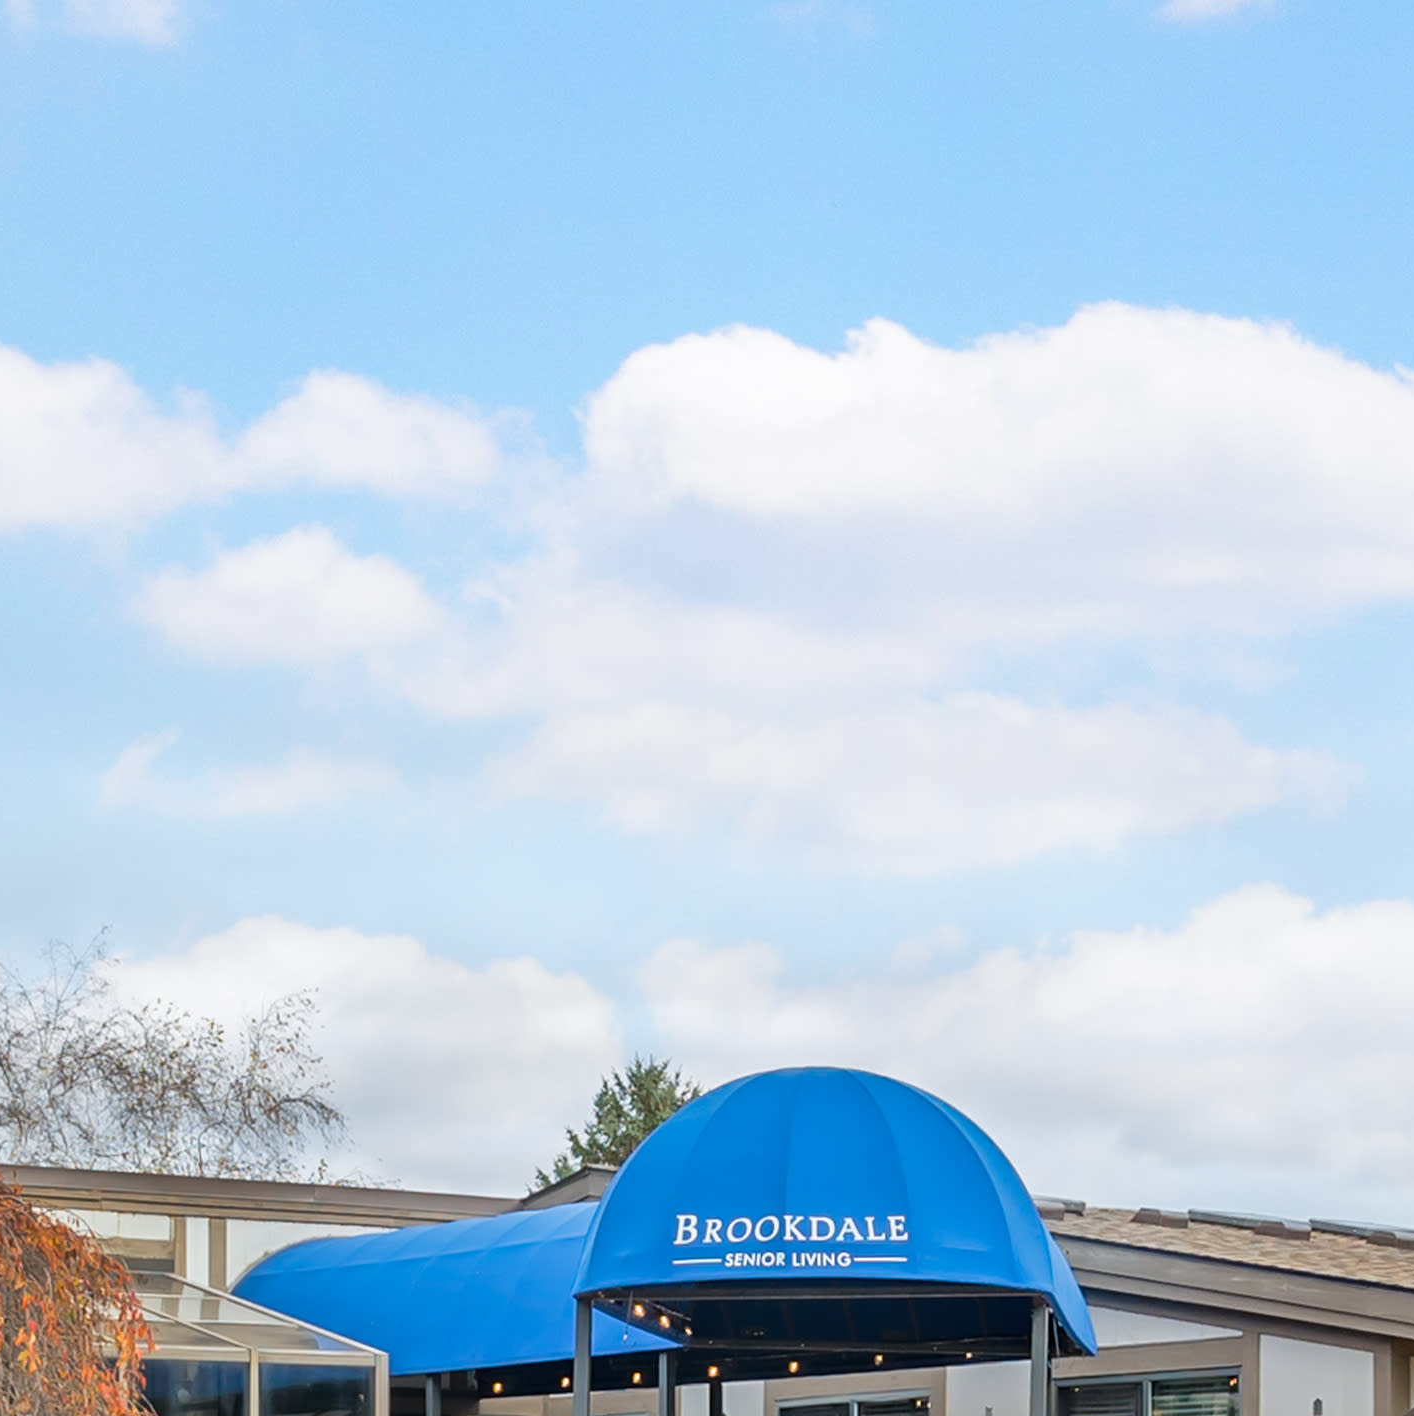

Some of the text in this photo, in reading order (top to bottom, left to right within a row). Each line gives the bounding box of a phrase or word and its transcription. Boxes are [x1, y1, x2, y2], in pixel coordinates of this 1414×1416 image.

[673, 1214, 909, 1246] BROOKDALE
[724, 1251, 852, 1268] SENIOR LIVING
